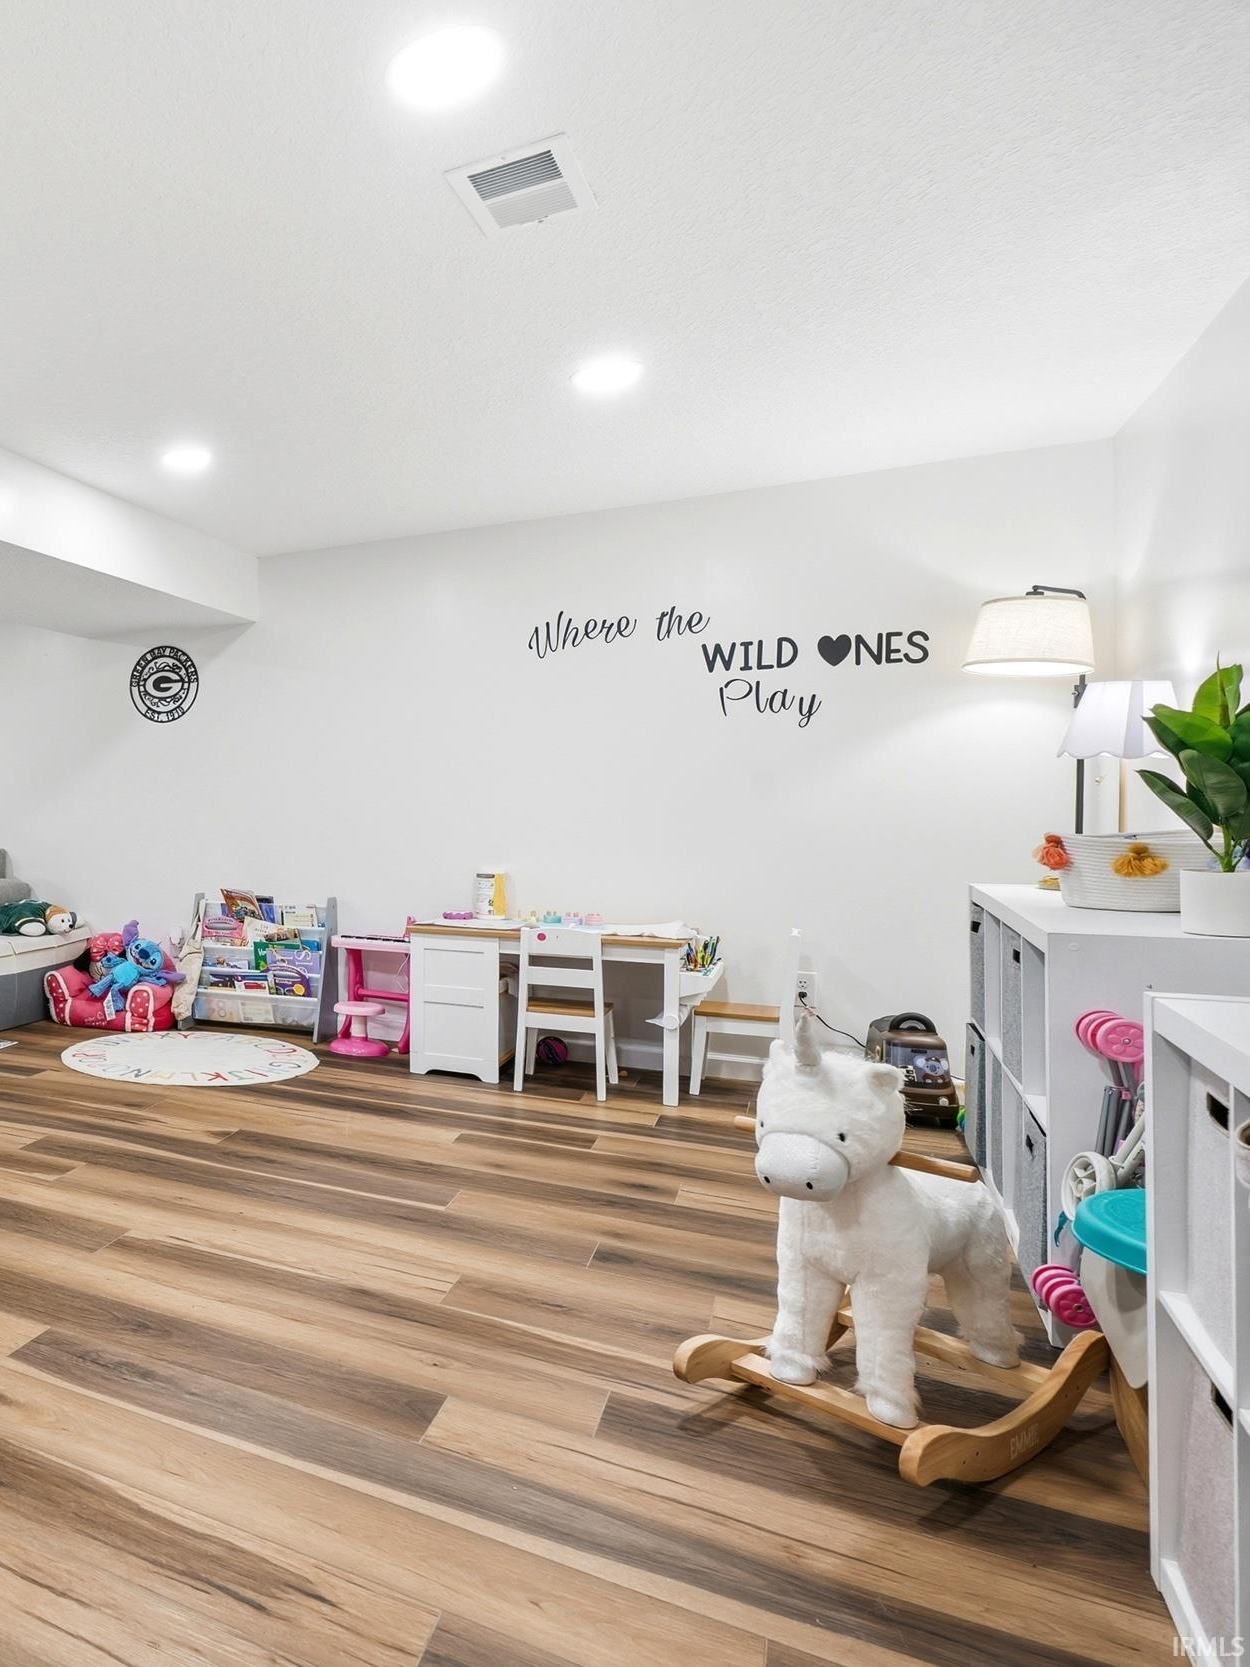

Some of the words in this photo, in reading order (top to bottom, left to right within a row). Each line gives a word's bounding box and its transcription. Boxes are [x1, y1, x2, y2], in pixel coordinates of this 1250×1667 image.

[528, 610, 637, 660] Where
[655, 605, 710, 641] the
[700, 636, 799, 673] WILD
[718, 677, 823, 729] Play
